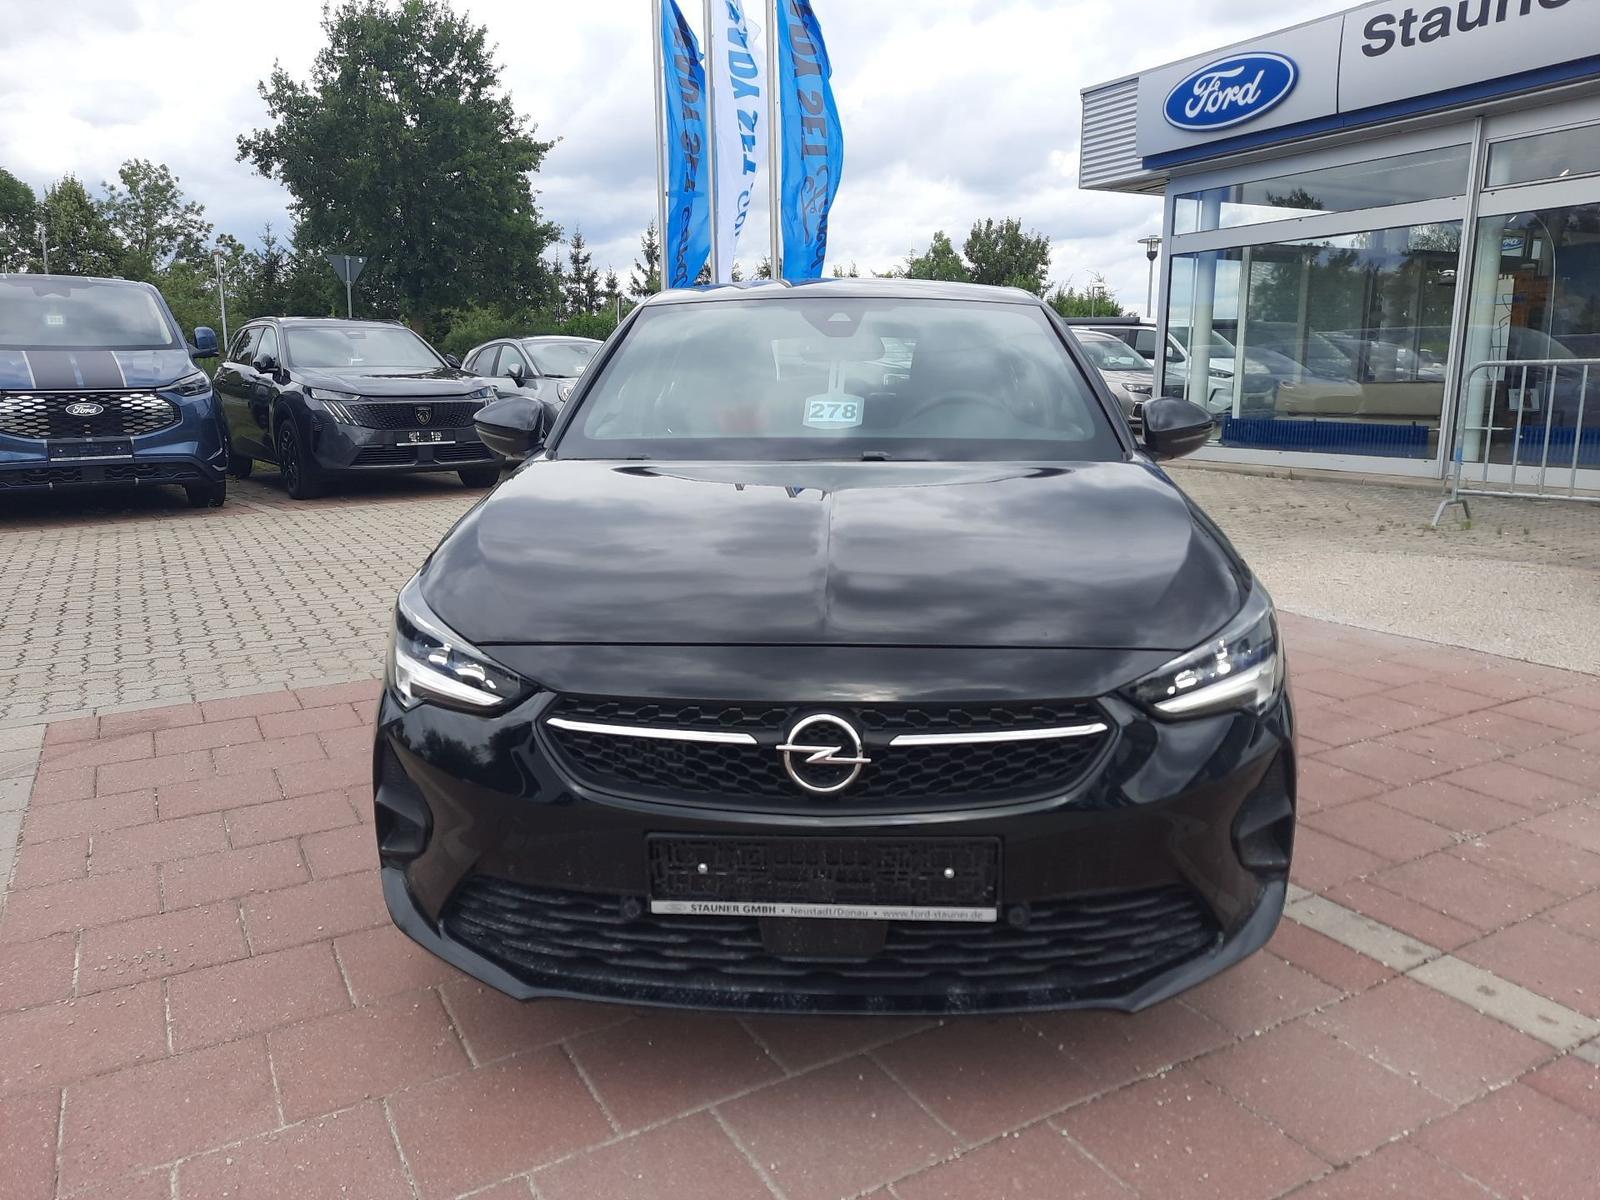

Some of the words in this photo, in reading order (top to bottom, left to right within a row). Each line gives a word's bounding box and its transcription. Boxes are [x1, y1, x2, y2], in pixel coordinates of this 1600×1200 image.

[1361, 0, 1573, 57] Stau
[1184, 65, 1264, 118] Ford
[810, 403, 857, 419] 278
[690, 902, 739, 914] STAUNER
[742, 903, 776, 915] GMBH
